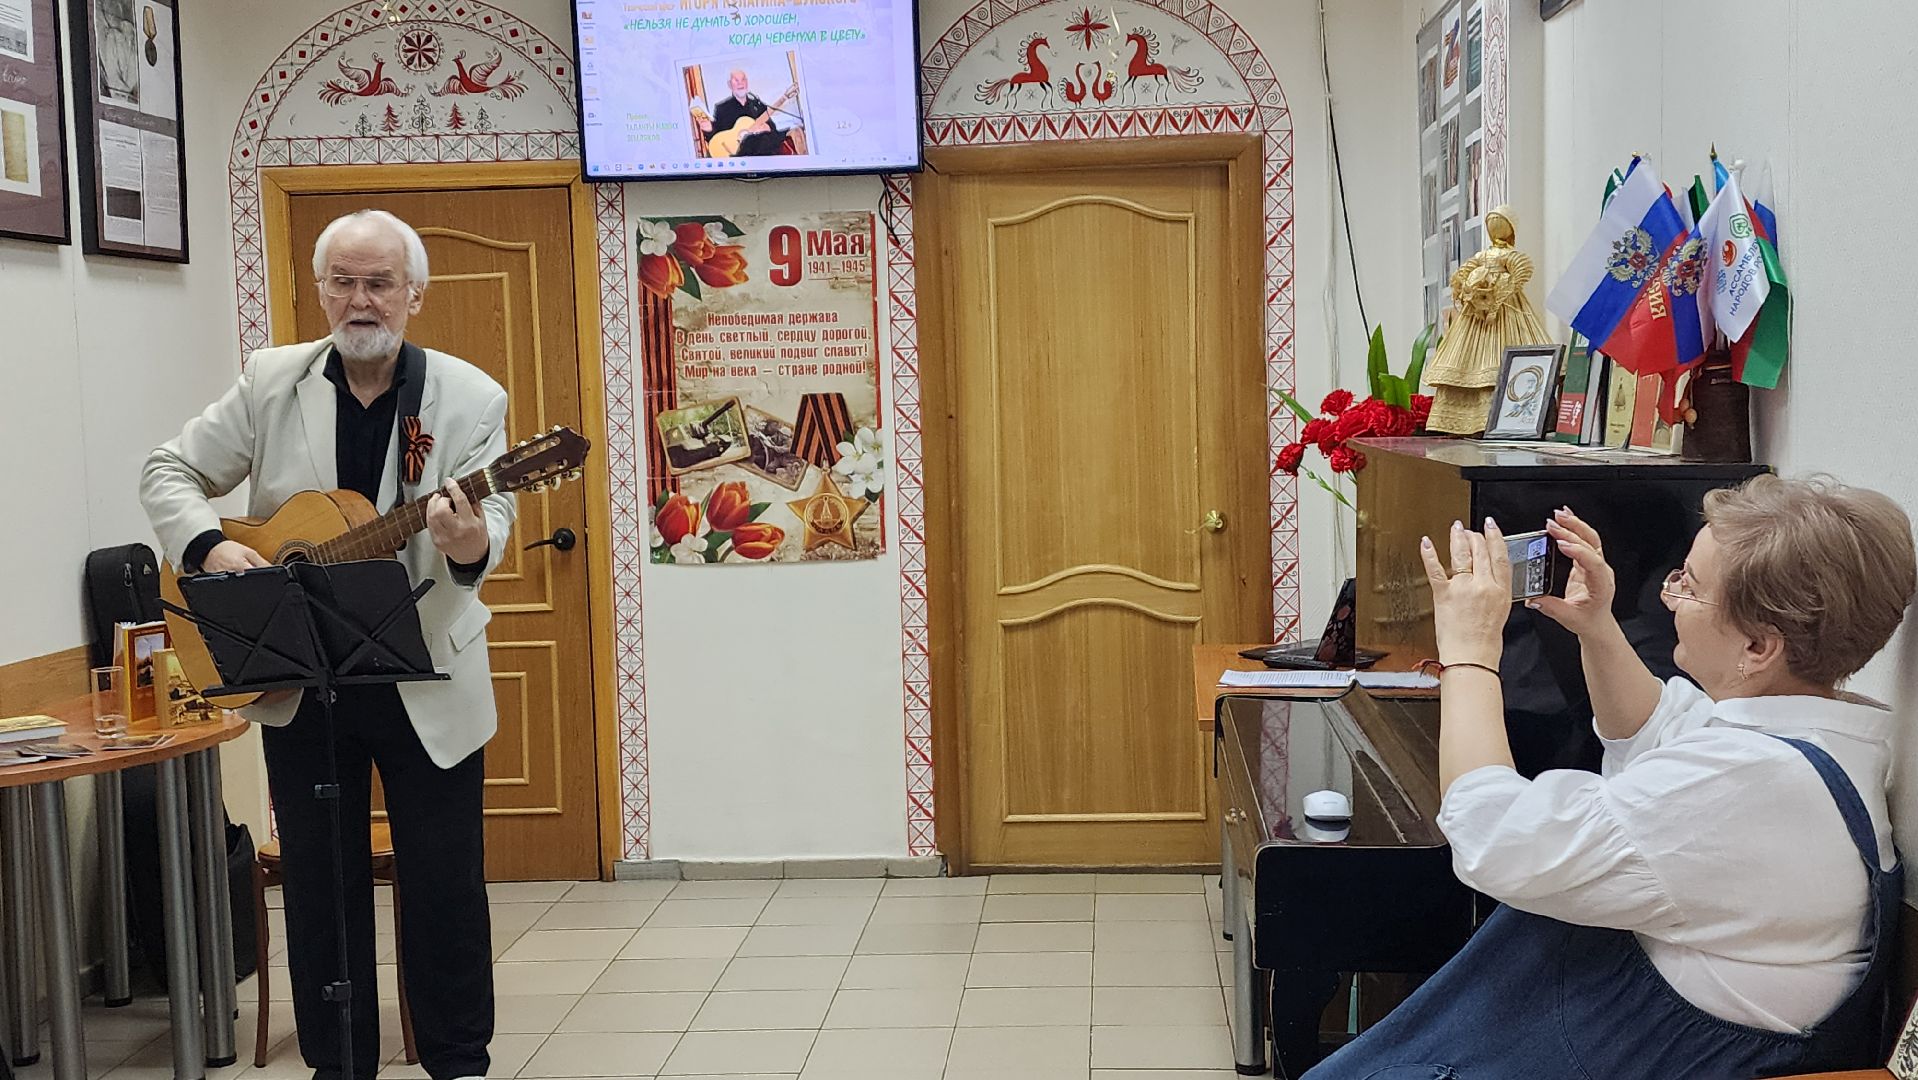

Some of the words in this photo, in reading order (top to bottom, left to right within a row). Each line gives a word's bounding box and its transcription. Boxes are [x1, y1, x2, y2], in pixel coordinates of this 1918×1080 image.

[623, 18, 671, 31] «НЕЛЬЗЯ
[675, 17, 689, 29] НЕ
[691, 16, 730, 31] ДУМАТЬ
[728, 33, 762, 47] КОГДА
[820, 30, 827, 41] В
[830, 29, 866, 45] ЦВЕТУ»
[806, 229, 865, 257] Мая
[768, 225, 802, 287] 9
[1729, 269, 1758, 316] НАРОДОВ
[707, 312, 784, 327] Непобедимая
[788, 311, 838, 326] держава
[676, 330, 684, 344] В
[687, 331, 715, 346] день
[777, 328, 816, 343] сердцу
[681, 346, 726, 362] Святой,
[729, 345, 776, 360] великий
[780, 346, 818, 360] подвиг
[823, 342, 868, 358] славит!
[684, 364, 708, 380] Мир
[712, 366, 726, 378] на
[730, 365, 757, 377] века
[778, 363, 818, 377] стране
[822, 361, 866, 376] родной!
